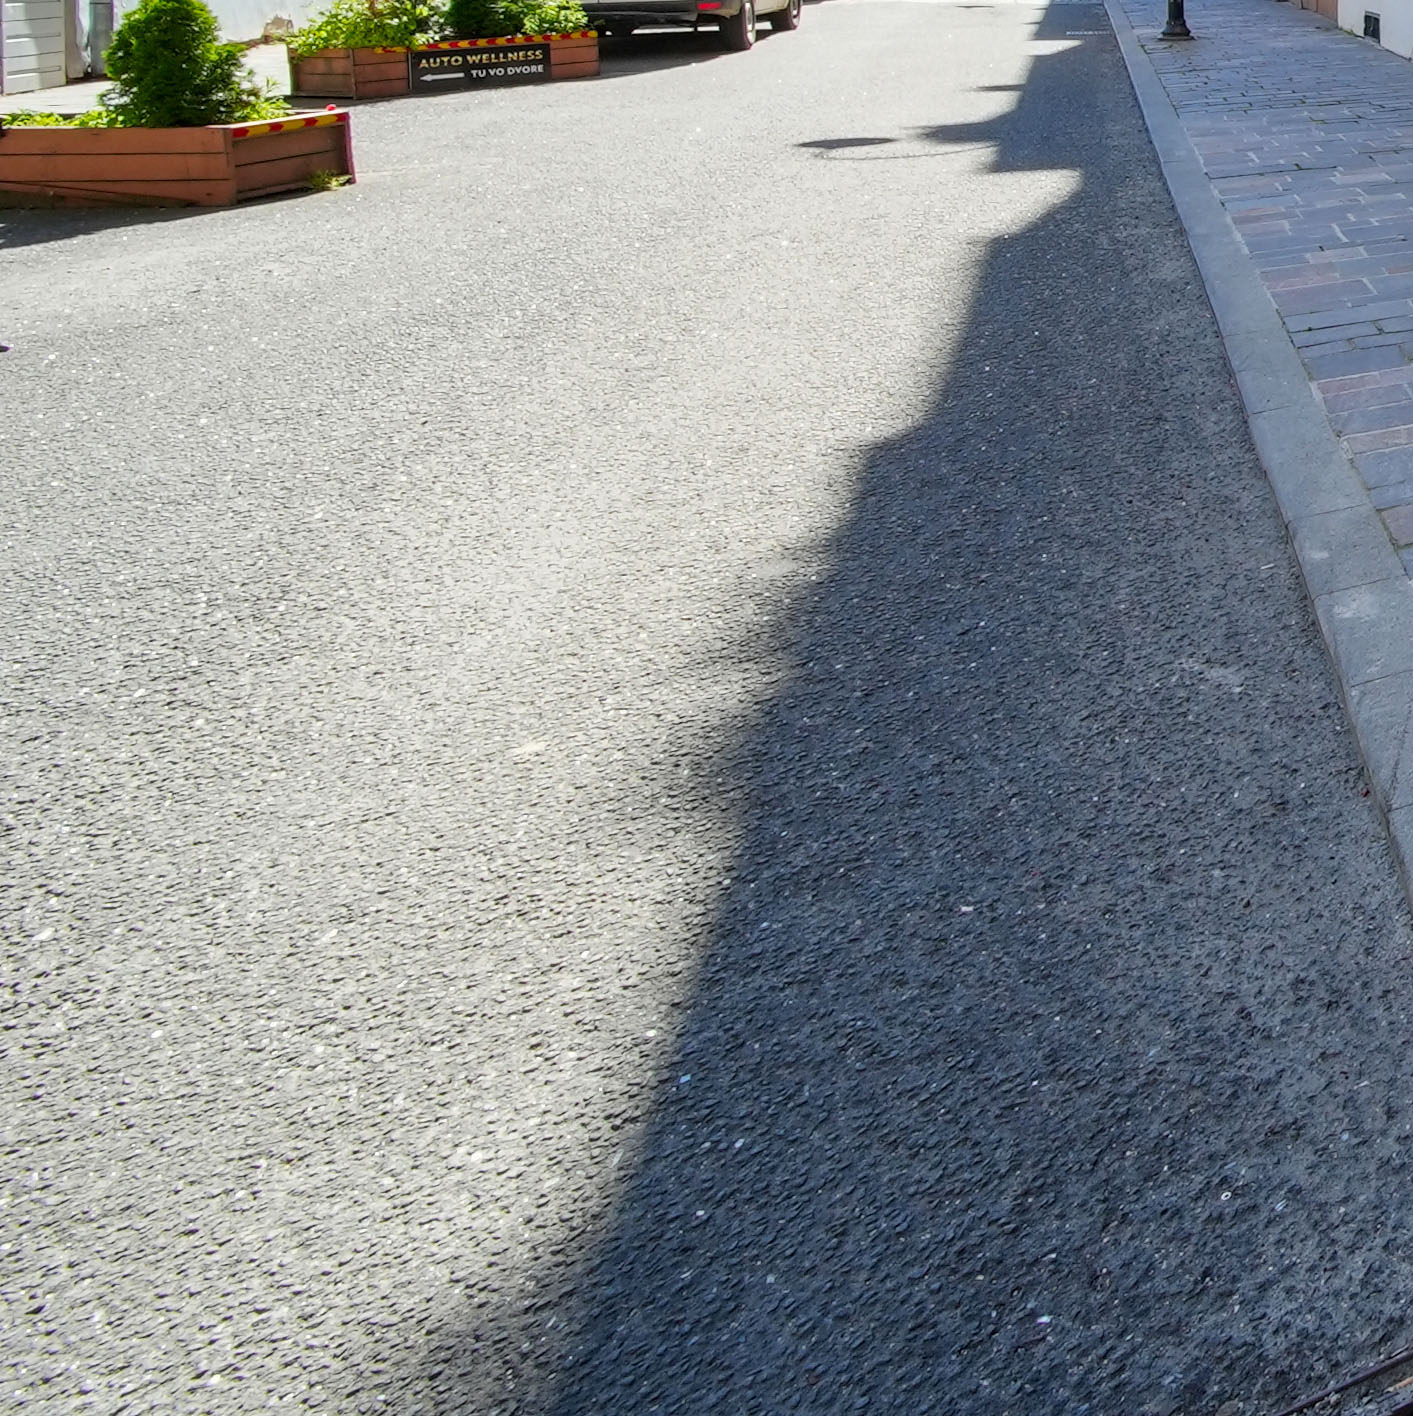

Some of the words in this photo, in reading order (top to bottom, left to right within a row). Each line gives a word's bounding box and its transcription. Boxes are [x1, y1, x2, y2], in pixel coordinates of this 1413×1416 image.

[419, 55, 463, 68] AUTO
[466, 50, 543, 64] WELLNESS
[471, 69, 487, 78] TU
[488, 67, 505, 76] VO
[507, 64, 544, 75] DVORE
